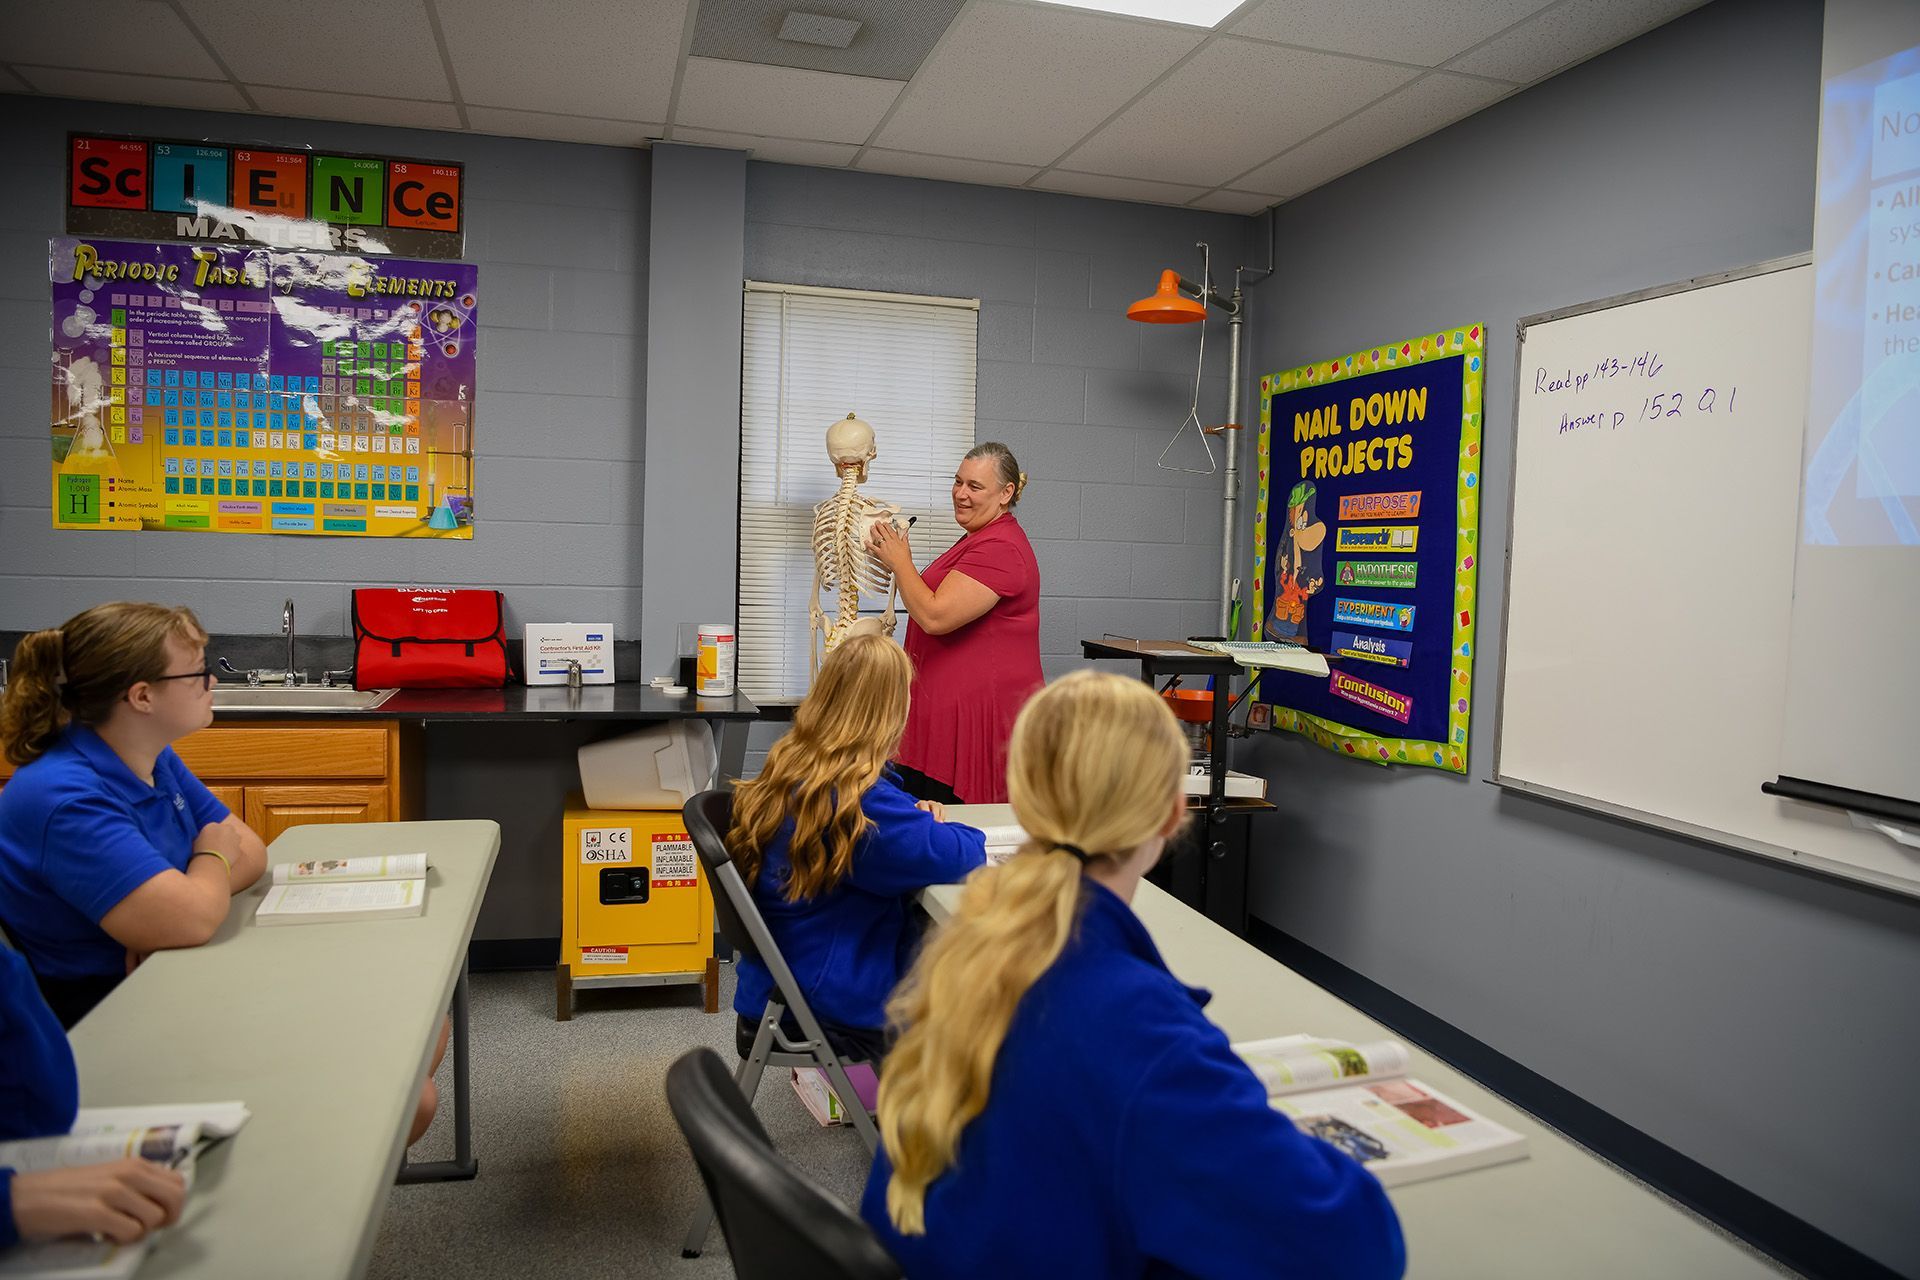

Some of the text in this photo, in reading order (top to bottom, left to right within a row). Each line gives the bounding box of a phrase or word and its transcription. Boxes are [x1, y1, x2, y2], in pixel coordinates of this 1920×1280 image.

[77, 140, 90, 150] 21
[157, 145, 170, 155] 53
[238, 152, 250, 161] 63
[316, 158, 323, 166] 7
[394, 164, 407, 174] 58
[73, 244, 179, 281] PERIODIC
[146, 311, 170, 319] periodic
[154, 318, 182, 326] increasing
[1534, 367, 1572, 395] Read
[1294, 386, 1428, 444] NAIL DOWN
[1559, 411, 1605, 435] Answer
[1639, 393, 1684, 423] 152
[1300, 434, 1413, 480] PROJECTS
[70, 494, 88, 514] H
[1350, 494, 1408, 512] PURPOSE
[1341, 528, 1391, 545] Research
[1356, 564, 1415, 578] HYPOTHESIS
[1338, 600, 1396, 618] EXPERIMENT
[1352, 635, 1386, 654] Analysis
[1337, 675, 1406, 714] Conclusion
[586, 849, 627, 861] OSHA
[656, 844, 692, 852] FLAMMABLE
[656, 866, 693, 874] INFLAMABLE
